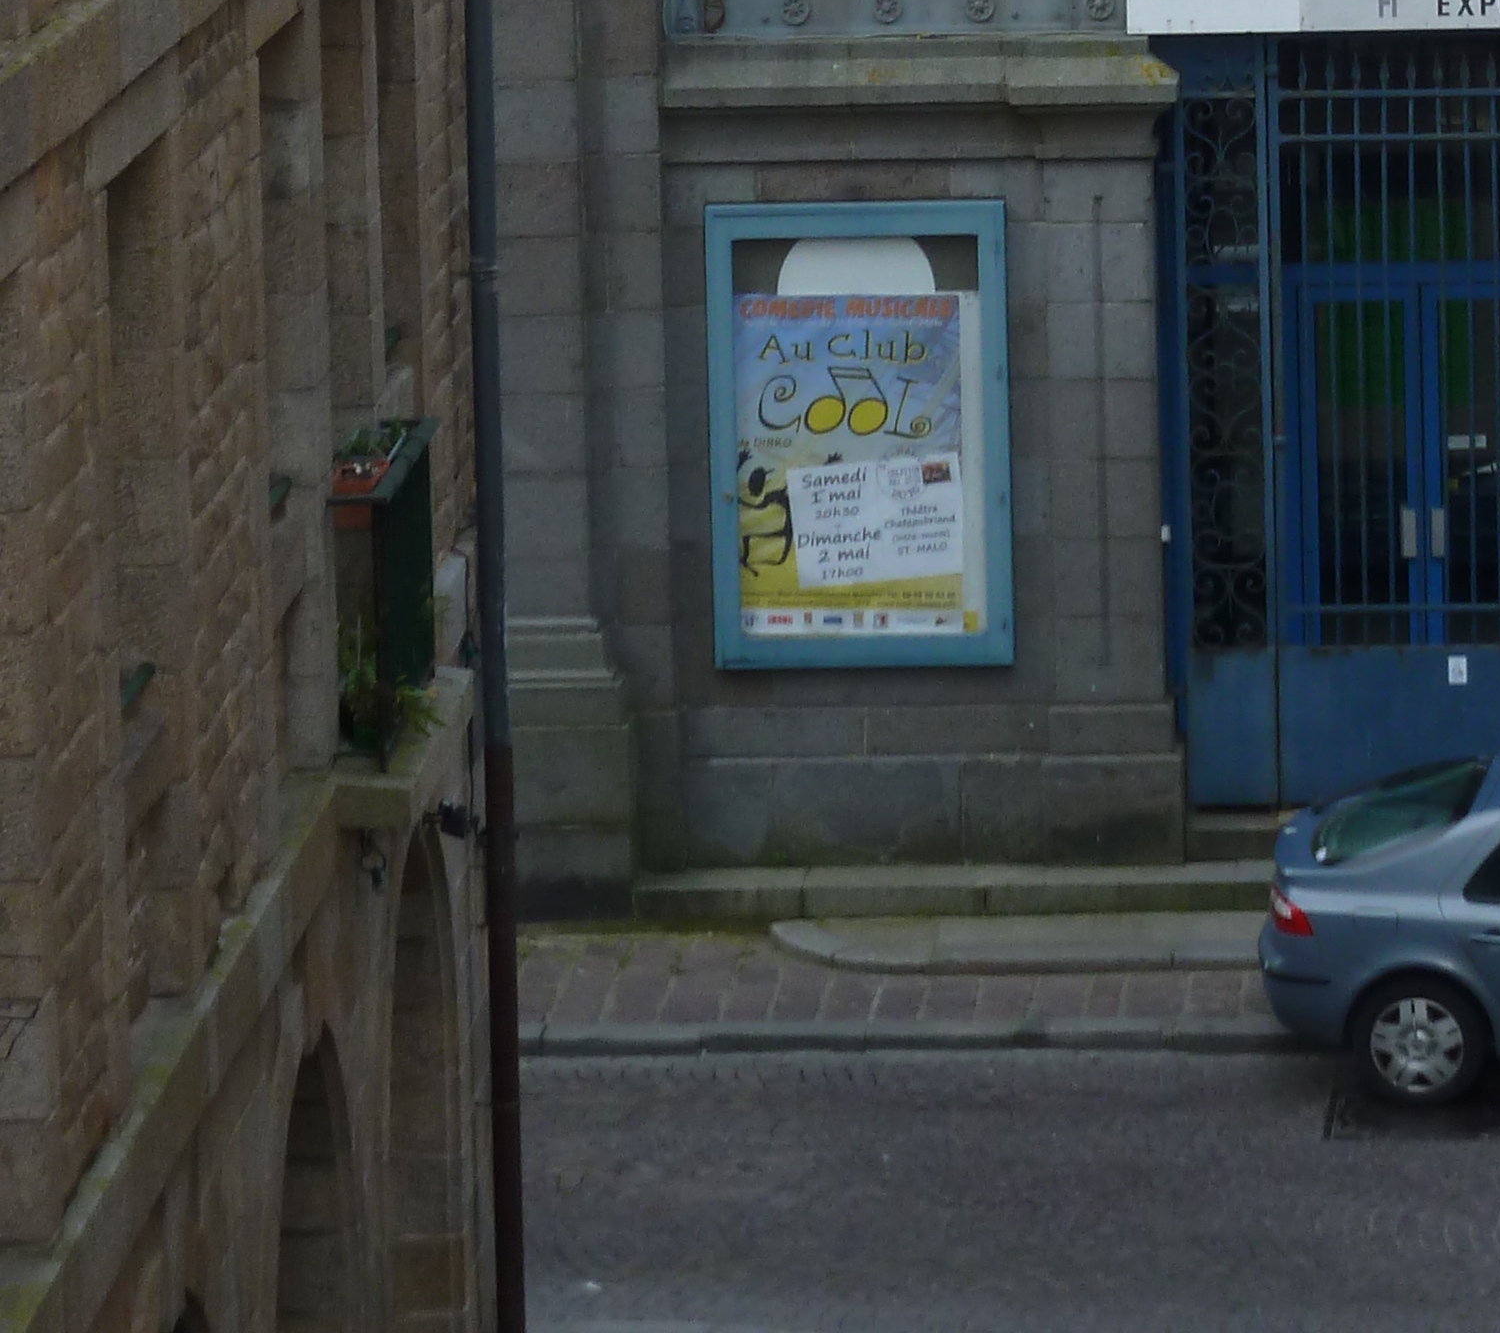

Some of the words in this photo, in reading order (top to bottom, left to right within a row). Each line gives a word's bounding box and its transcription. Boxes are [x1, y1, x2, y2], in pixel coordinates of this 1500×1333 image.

[758, 333, 815, 363] Au
[827, 329, 929, 364] Club
[802, 467, 867, 489] Samedi
[829, 484, 862, 503] mai
[797, 527, 881, 549] Dimanche
[838, 543, 871, 562] mai
